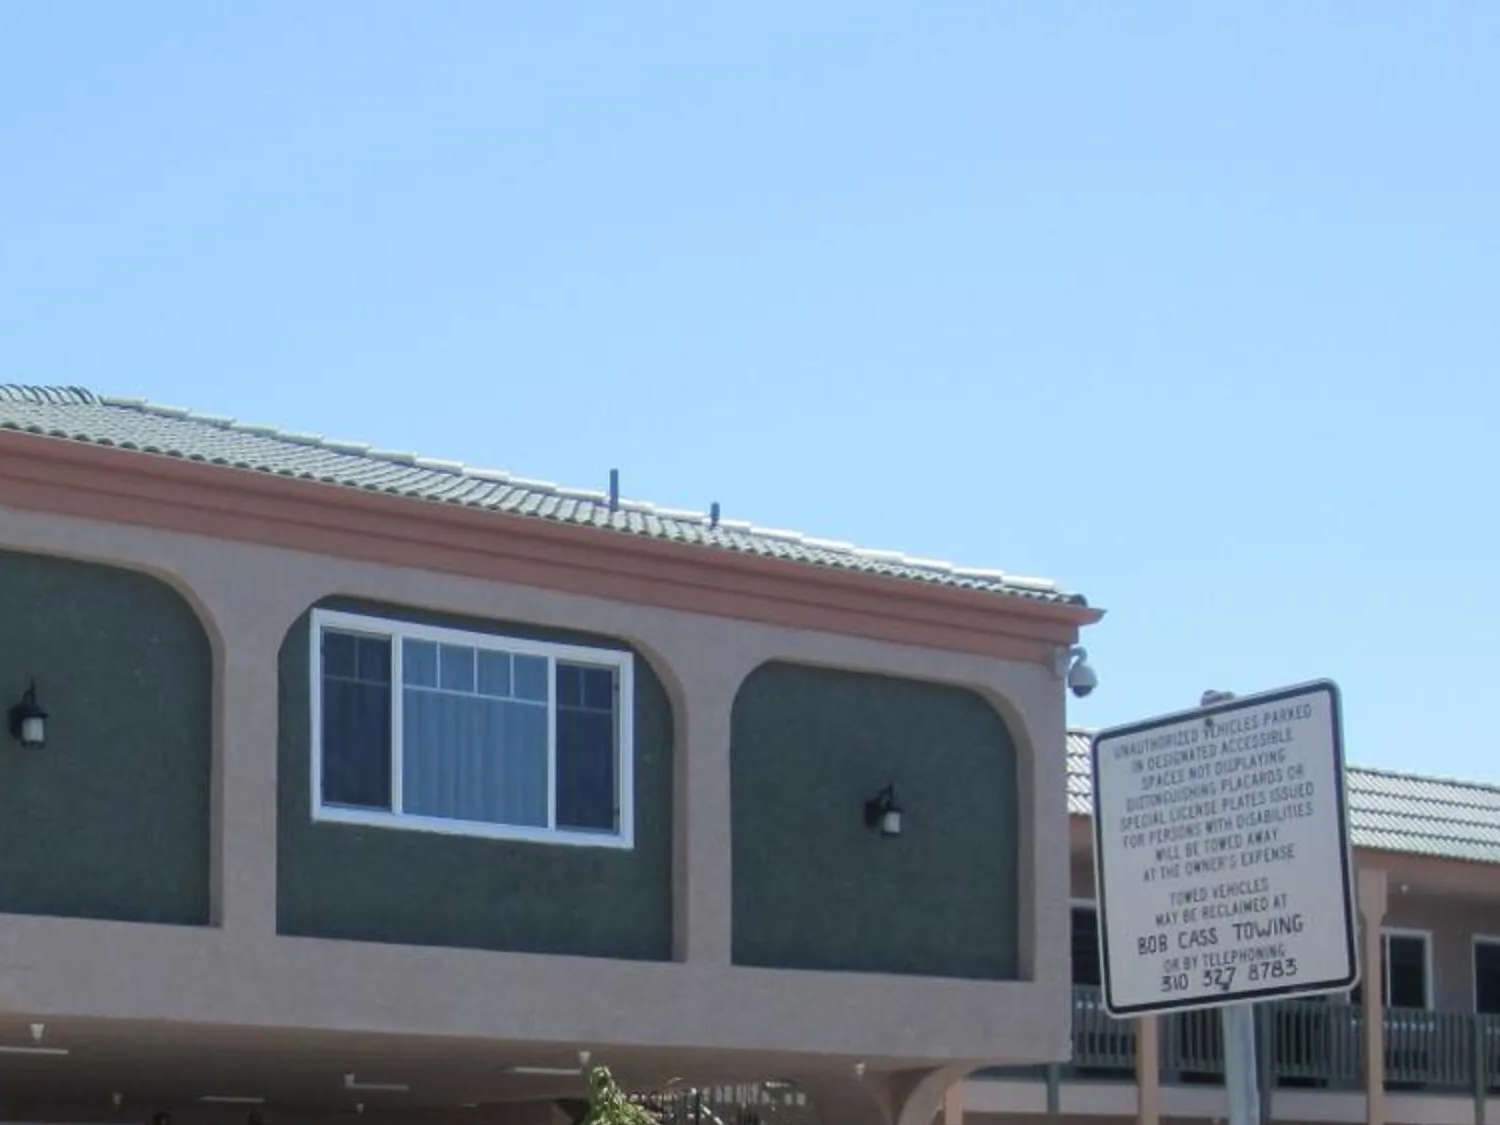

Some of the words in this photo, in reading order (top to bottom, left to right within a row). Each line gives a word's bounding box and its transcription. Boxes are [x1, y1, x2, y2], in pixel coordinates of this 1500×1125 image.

[1204, 714, 1260, 740] VEHICLES
[1263, 704, 1313, 728] PARKED
[1147, 745, 1217, 771] DESIGNATED
[1221, 728, 1294, 755] ACCESSIBLE
[1141, 769, 1185, 791] SPACES
[1189, 763, 1211, 780] NOT
[1214, 748, 1286, 776] DISPLAYING
[1221, 769, 1284, 792] PLACARDS
[1120, 812, 1165, 833] SPECIAL
[1169, 800, 1218, 823] LICENSE
[1222, 791, 1266, 811] PLATES
[1269, 781, 1315, 803] ISSUED
[1123, 833, 1145, 849] FOR
[1150, 823, 1202, 845] PERSONS
[1205, 816, 1233, 834] WITH
[1236, 802, 1314, 829] DISABILITIES
[1144, 867, 1157, 882] AT
[1160, 863, 1180, 879] THE
[1241, 843, 1296, 867] EXPENSE
[1156, 846, 1180, 862] WILL
[1185, 841, 1200, 857] BE
[1204, 834, 1243, 853] TOWED
[1247, 828, 1279, 845] AWAY
[1169, 888, 1208, 906] TOWED
[1212, 877, 1270, 903] VEHICLES
[1155, 911, 1179, 927] MAY
[1183, 907, 1198, 924] BE
[1202, 897, 1270, 921] RECLAIMED
[1273, 893, 1288, 910] AT
[1137, 934, 1169, 955] BOB
[1178, 927, 1219, 949] CASS
[1232, 913, 1304, 941] TOWING
[1161, 973, 1189, 993] 310
[1203, 966, 1237, 988] 327
[1248, 957, 1298, 981] 8783
[1164, 958, 1179, 973] OR
[1184, 956, 1198, 971] BY
[1202, 943, 1285, 968] TELEPHONING
